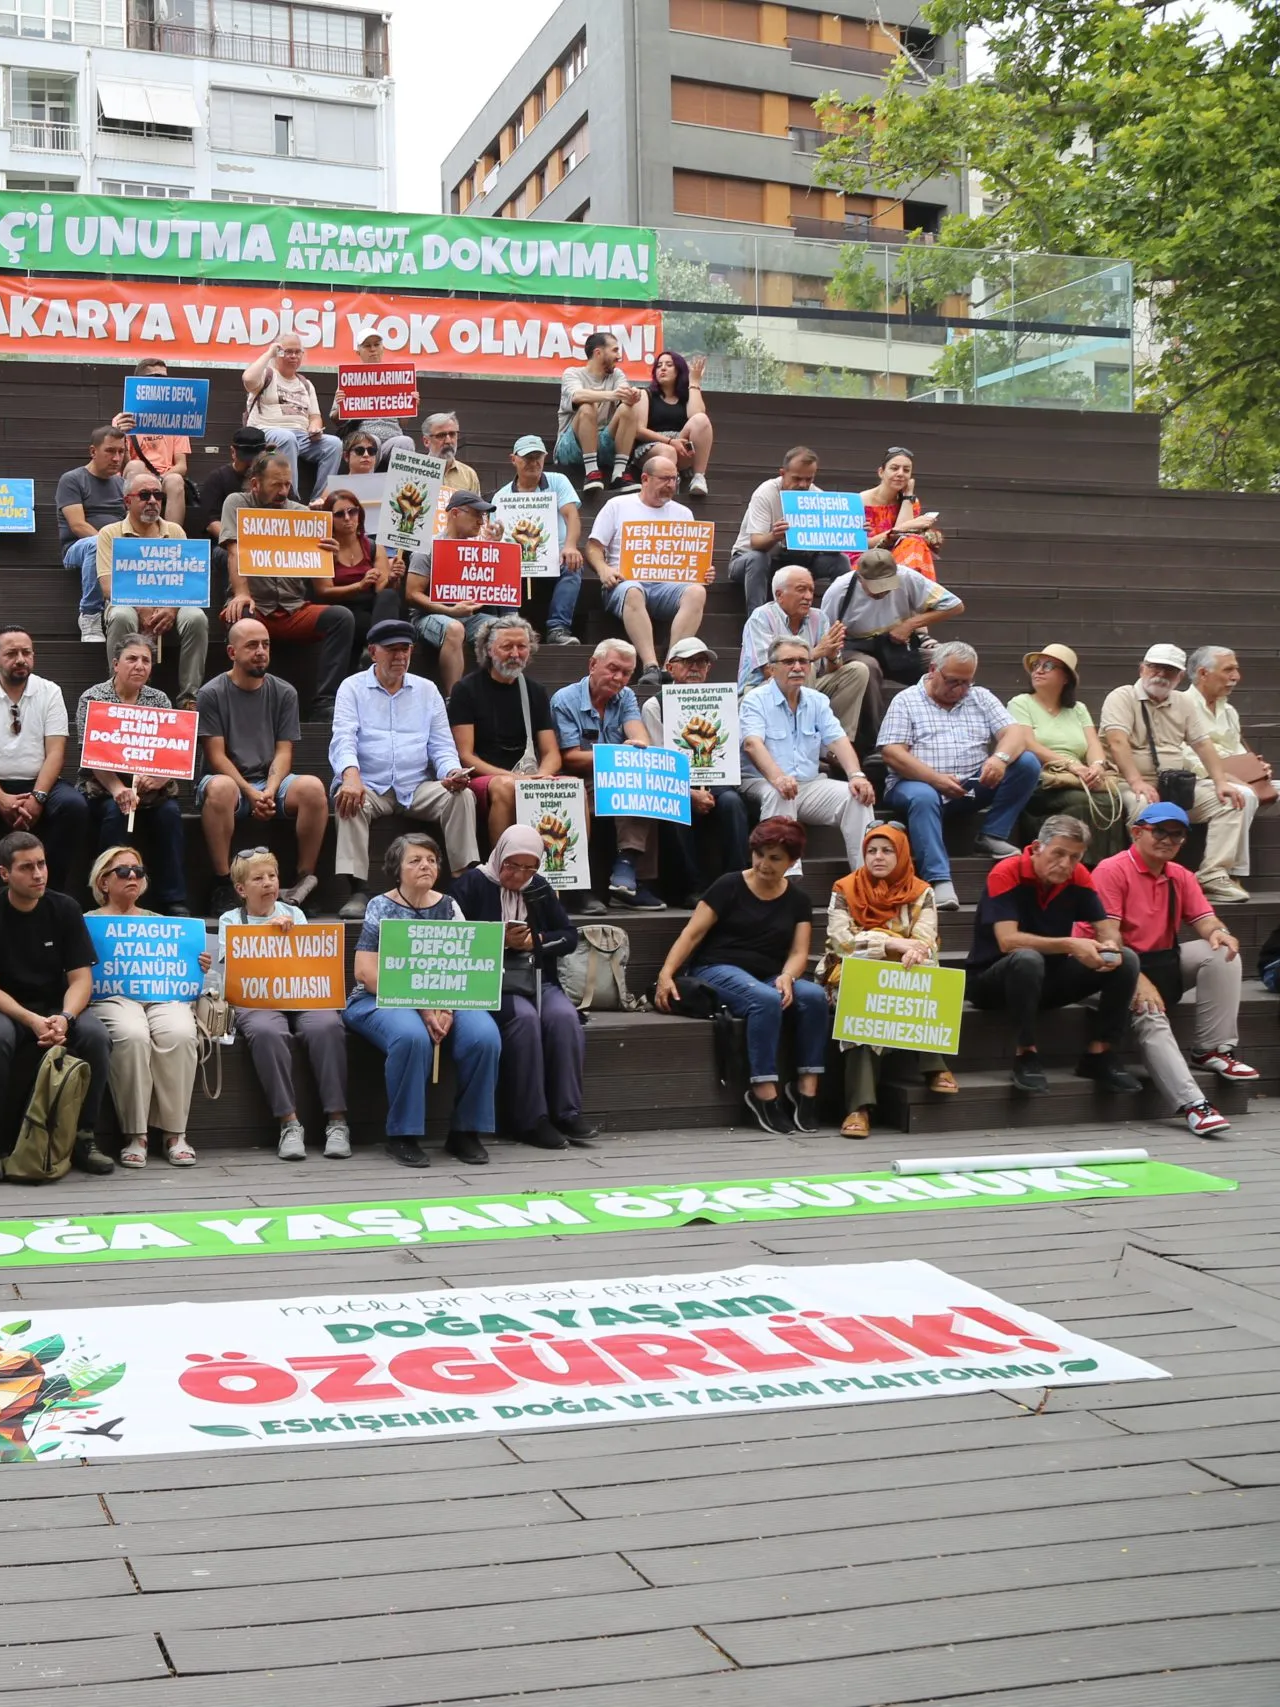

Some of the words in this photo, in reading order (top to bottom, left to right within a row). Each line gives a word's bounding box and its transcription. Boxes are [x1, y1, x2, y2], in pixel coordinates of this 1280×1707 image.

[64, 216, 276, 262] UNUTMA
[287, 222, 410, 250] ALPAGUT
[286, 247, 418, 275] ATALAN'A
[422, 234, 649, 283] DOKUNMA!
[182, 298, 336, 349] VADİSİ
[449, 318, 655, 365] OLMASN!
[340, 370, 414, 387] ORMANLARIMIZI
[136, 384, 170, 402] SERMAYE
[343, 393, 413, 411] VERMEYECEĞİZ
[138, 413, 180, 430] TOPRAKLAR
[182, 412, 202, 430] BİZİM
[797, 496, 849, 513] ESKİŞEHİR
[243, 518, 290, 537] SAKARYA
[292, 516, 327, 538] VADİSİ
[626, 522, 711, 539] YEŞİLLİĞİMİZ
[786, 514, 819, 528] MADEN
[822, 514, 863, 530] HAVZASI
[626, 540, 652, 551] HER
[655, 538, 708, 554] ŞEYİMİZ
[797, 532, 856, 547] OLMAYACAK
[140, 544, 182, 560] VAHŞİ
[250, 550, 273, 568] YOK
[275, 550, 322, 568] OLMASIN
[458, 547, 479, 561] TEK
[482, 545, 499, 563] BİR
[116, 558, 206, 572] MADENCİLİĞE
[461, 563, 494, 582] AĞACI
[632, 565, 698, 581] VERMEYİZ
[137, 573, 184, 586] HAYIR!
[436, 584, 517, 602] VERMEYECEĞİZ
[108, 706, 177, 724] SERMAYE
[121, 720, 158, 735] ELİNİ
[90, 729, 190, 751] DOĞAMIZDAN
[122, 747, 155, 762] ÇEK!
[614, 750, 676, 773] ESKİŞEHİR
[597, 771, 642, 789] MADEN
[645, 776, 689, 798] HAVZASI
[611, 796, 680, 816] OLMAYACAK
[105, 923, 186, 938] ALPAGUT-
[408, 925, 476, 939] SERMAYE
[113, 941, 178, 957] ATALAN
[232, 935, 292, 959] SAKARYA
[295, 929, 338, 958] VADİSİ
[411, 940, 471, 956] DEFOL!
[103, 959, 188, 977] SİYANÜRÜ
[385, 956, 406, 969] BU
[408, 957, 495, 971] TOPRAKLAR
[92, 979, 126, 996] HAK
[130, 977, 198, 996] ETMİYOR
[241, 978, 269, 999] YOK
[273, 977, 330, 998] OLMASIN
[411, 971, 467, 991] BİZİM!
[878, 969, 931, 992] ORMAN
[866, 993, 938, 1019] NEFESTİR
[843, 1016, 952, 1046] KESEMEZSİNİZ
[196, 1200, 590, 1245] YAŞAM
[594, 1165, 1130, 1218] ÖZGÜRLÜK!
[279, 1299, 407, 1318] mutlu
[416, 1289, 471, 1310] bir
[481, 1283, 595, 1304] hayat
[324, 1310, 535, 1345] DOĞA
[532, 1294, 800, 1330] YAŞAM
[178, 1306, 1061, 1404] ÖZGÜRLÜK!
[259, 1406, 479, 1437] ESKİŞEHİR
[492, 1390, 615, 1419] DOĞA
[614, 1391, 673, 1408] VE
[674, 1380, 819, 1406] YAŞAM
[818, 1362, 1056, 1393] PLATFORMU
